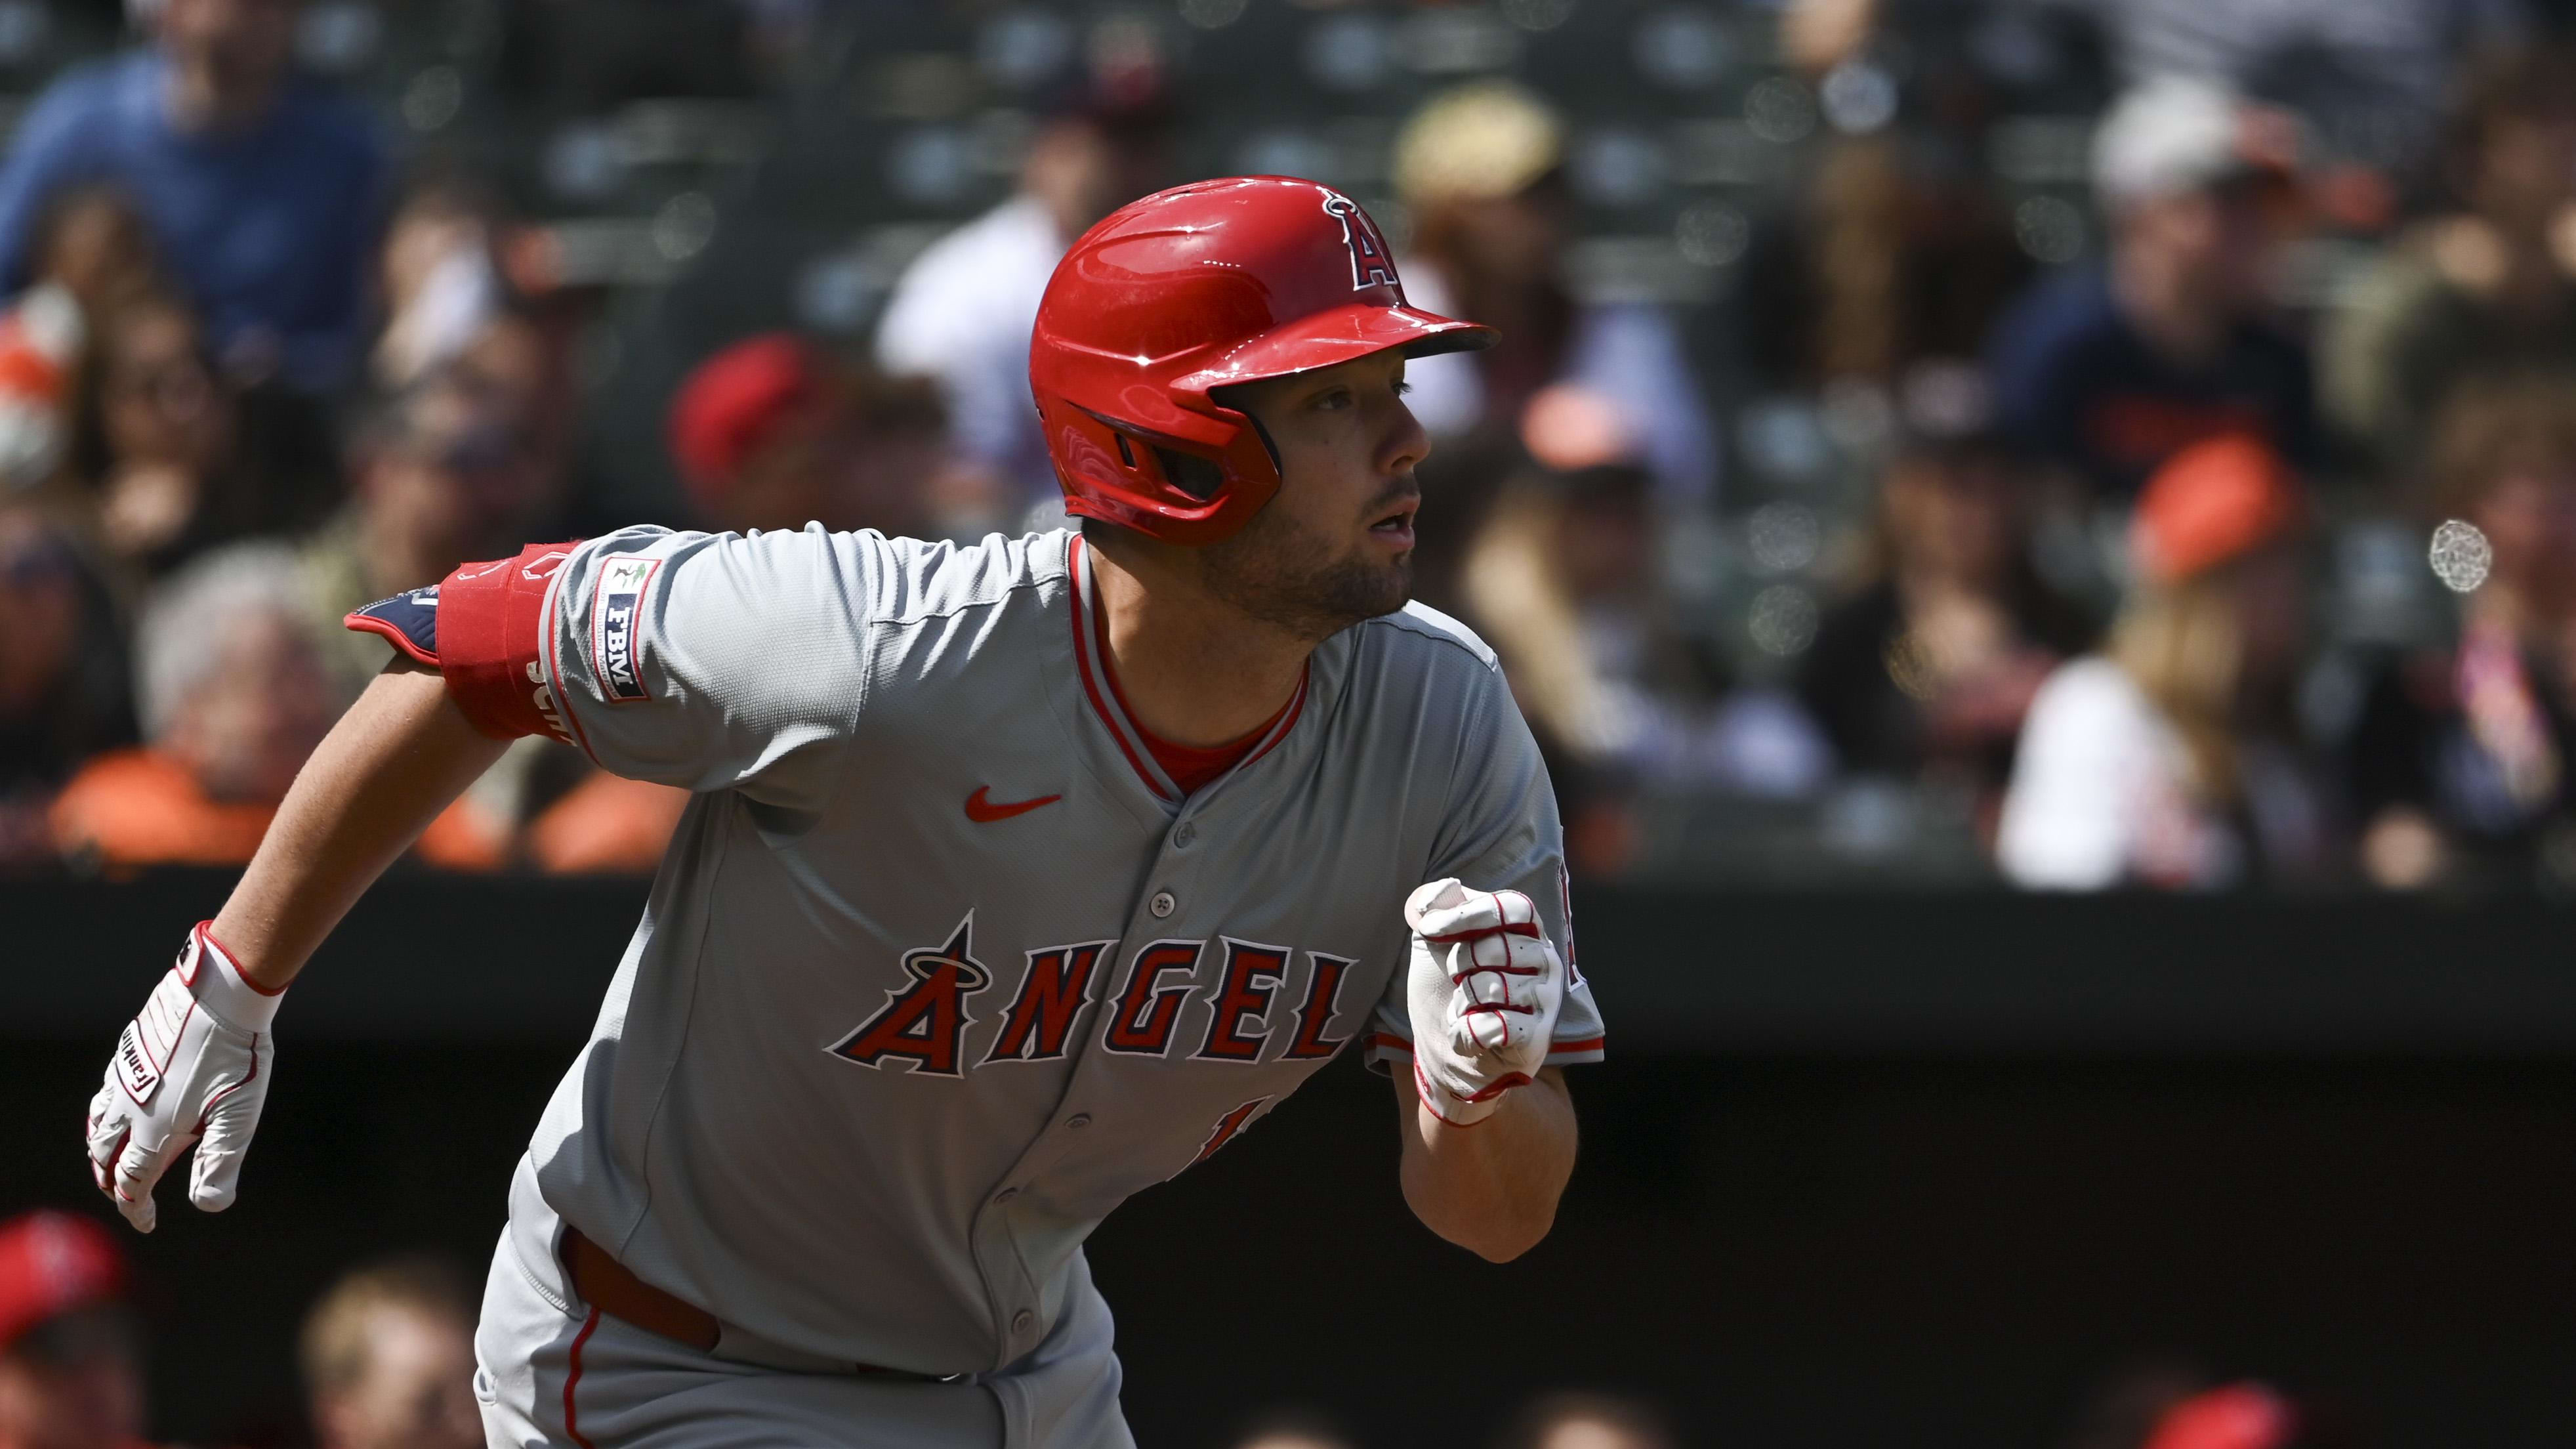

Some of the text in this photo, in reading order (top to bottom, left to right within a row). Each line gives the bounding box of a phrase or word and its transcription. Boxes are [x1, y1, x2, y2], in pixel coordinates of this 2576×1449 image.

[1315, 186, 1398, 291] A
[596, 608, 605, 651] Building
[607, 606, 633, 686] FBM
[121, 1028, 156, 1093] Franklin
